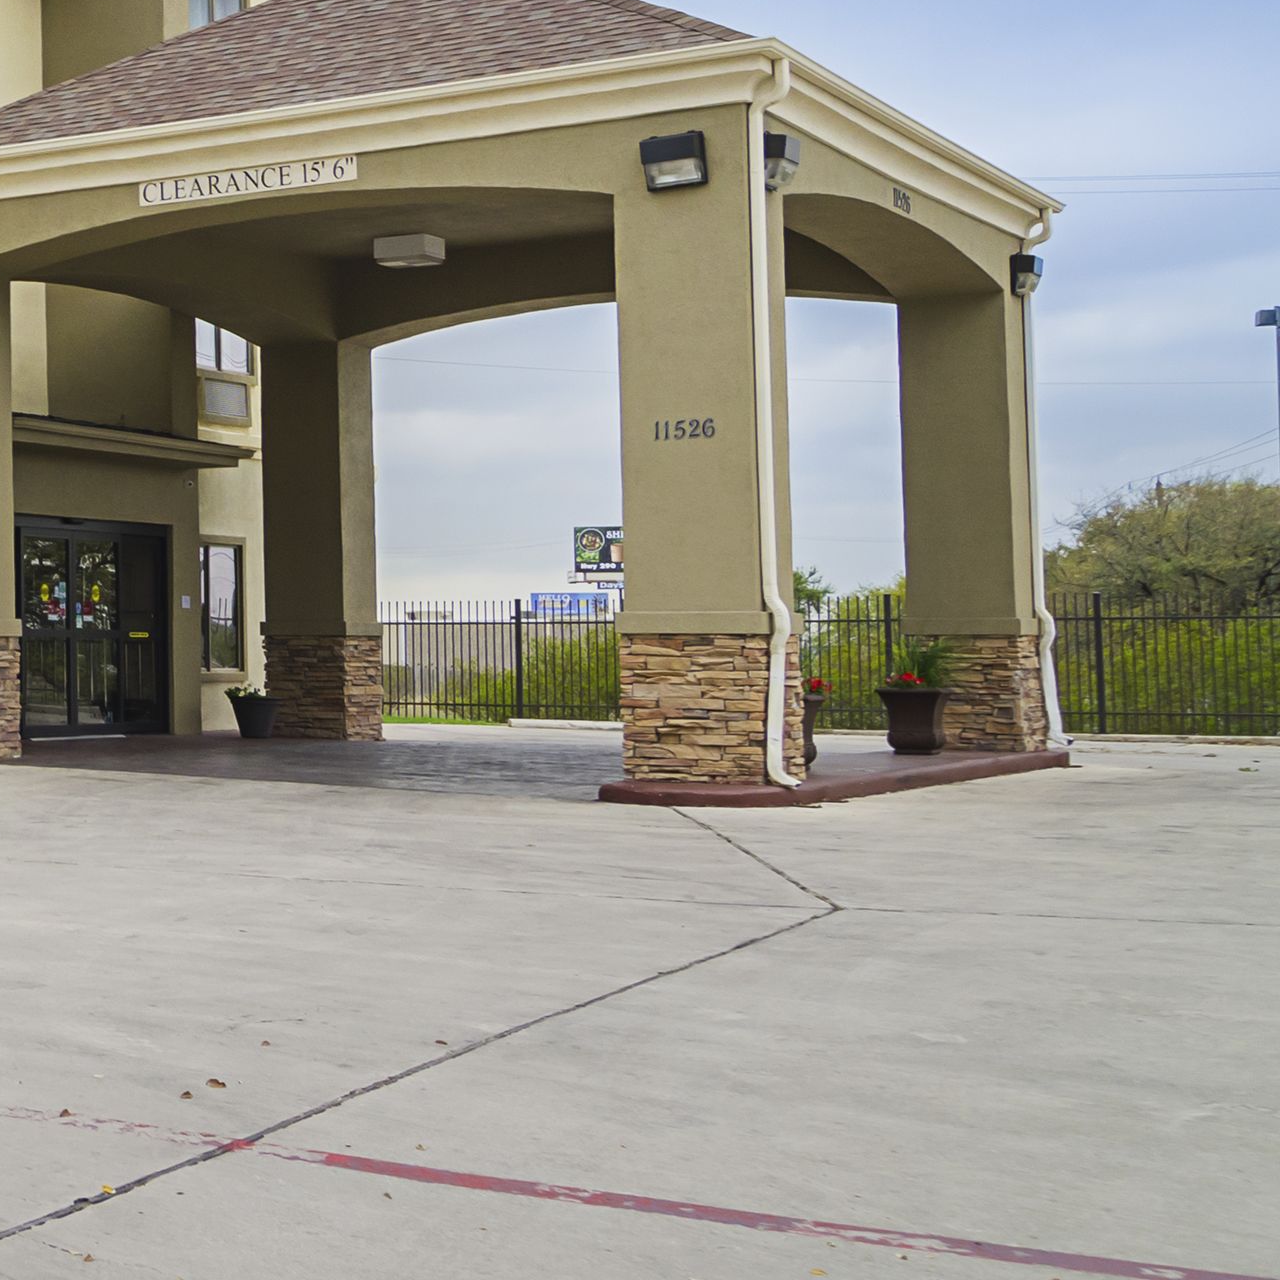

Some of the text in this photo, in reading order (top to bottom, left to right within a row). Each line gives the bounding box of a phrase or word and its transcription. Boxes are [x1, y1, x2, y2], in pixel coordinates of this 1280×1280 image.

[142, 165, 292, 203] CLEARANCE
[302, 160, 325, 184] 15'
[654, 418, 715, 440] 11526
